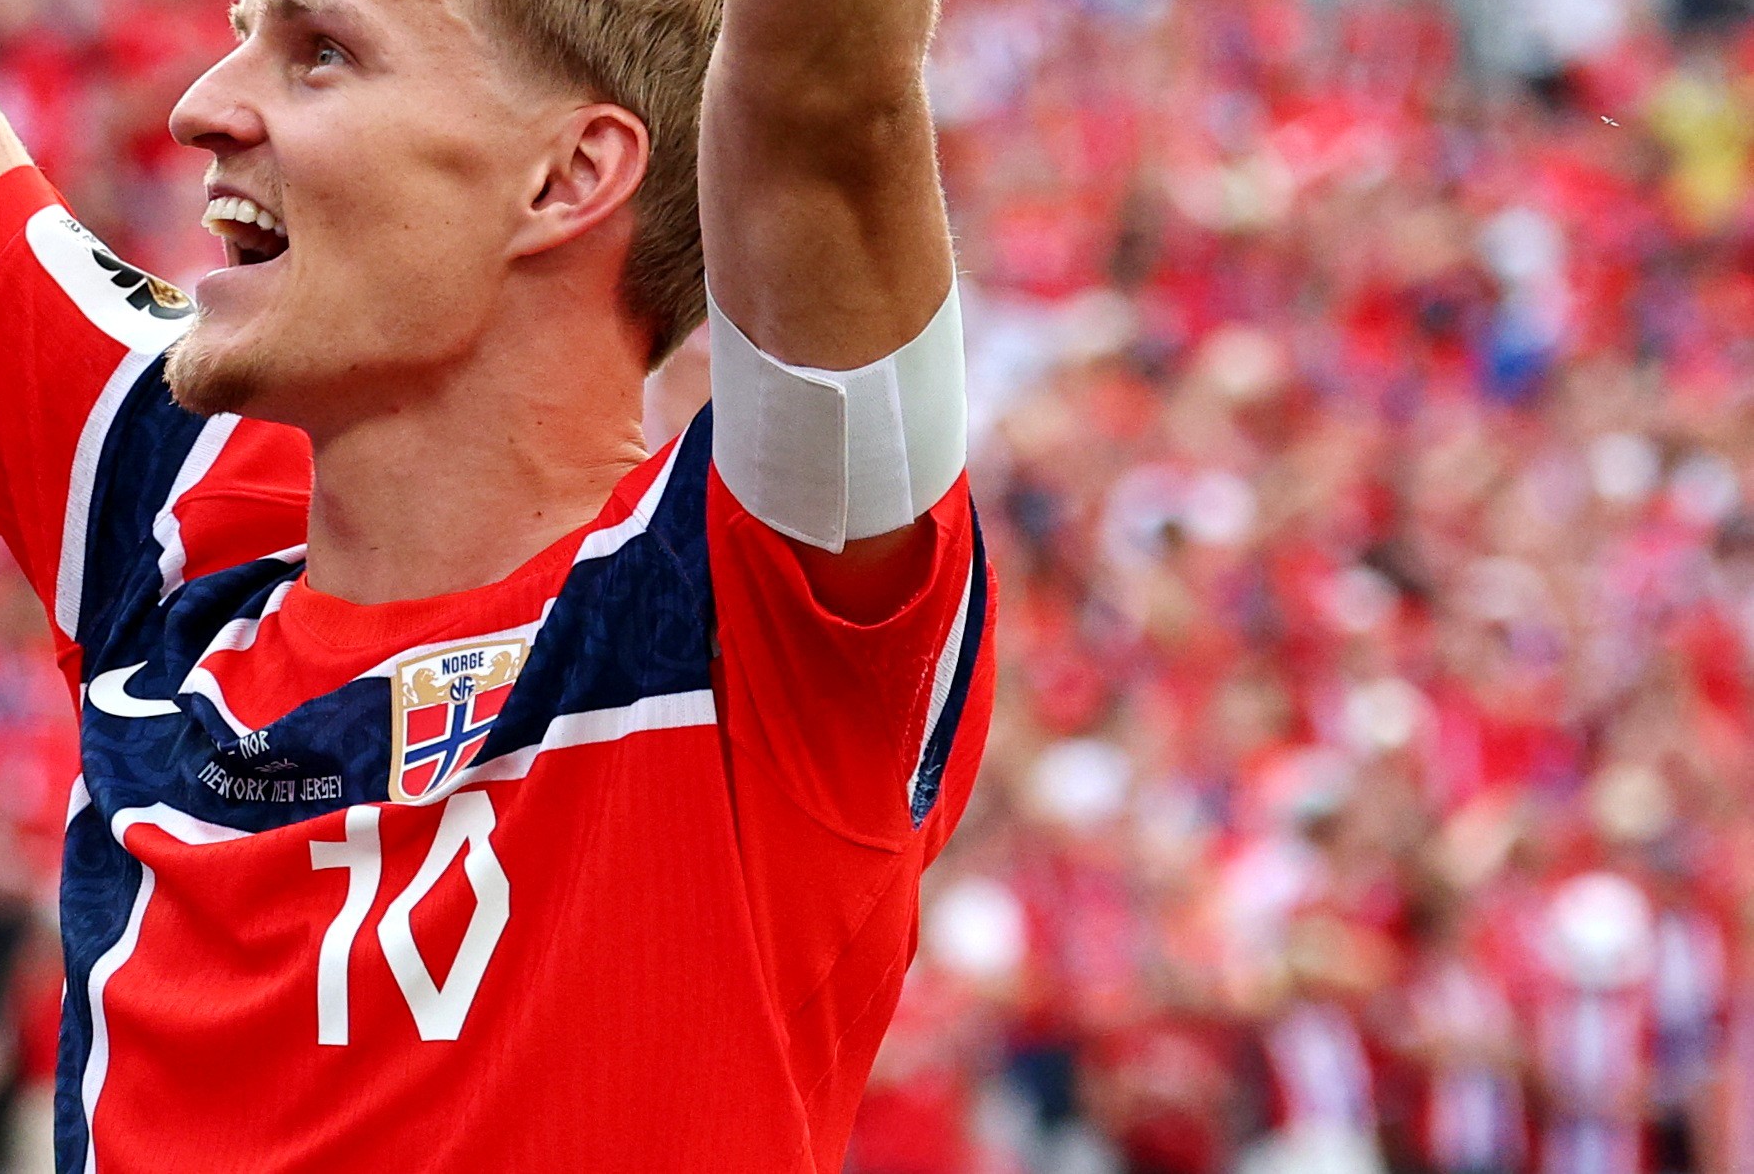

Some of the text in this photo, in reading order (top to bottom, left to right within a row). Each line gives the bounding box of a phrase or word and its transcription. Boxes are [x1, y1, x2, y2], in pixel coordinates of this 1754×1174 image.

[442, 651, 484, 675] NORGE
[240, 730, 270, 759] NOR
[271, 780, 296, 802] NEW
[300, 775, 342, 801] JERSEY
[310, 790, 510, 1045] 10
